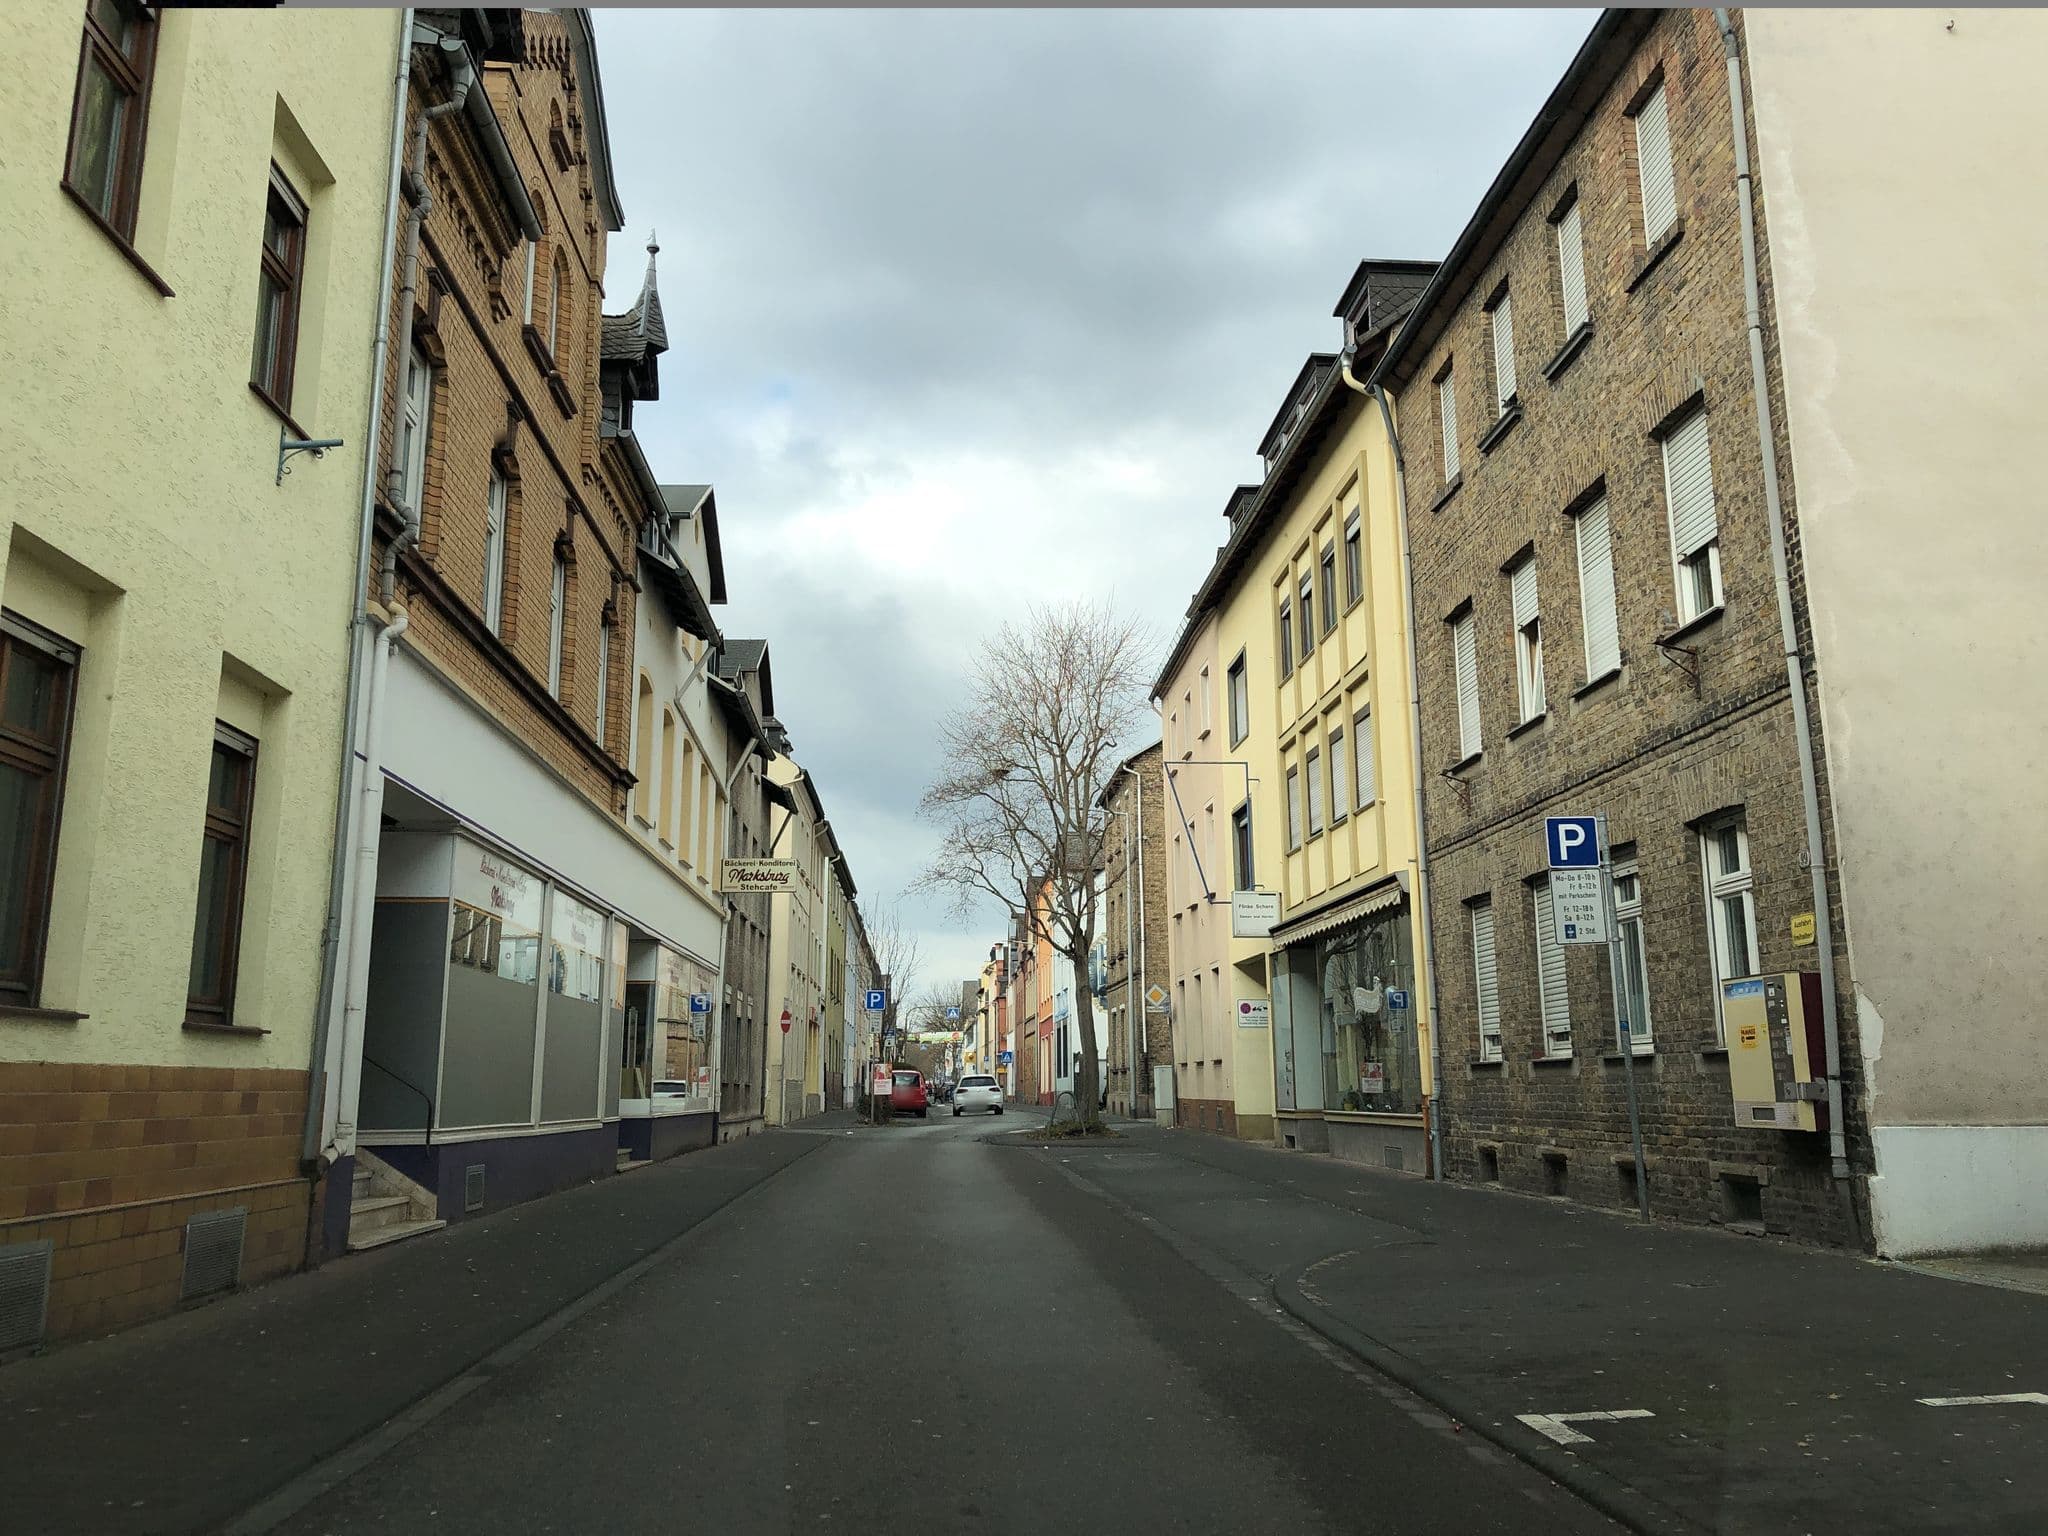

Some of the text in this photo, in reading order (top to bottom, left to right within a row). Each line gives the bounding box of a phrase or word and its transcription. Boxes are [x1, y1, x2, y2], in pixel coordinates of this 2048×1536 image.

[1558, 823, 1585, 860] P
[729, 868, 791, 885] Marksburg
[1578, 927, 1584, 935] 2
[870, 993, 881, 1008] P
